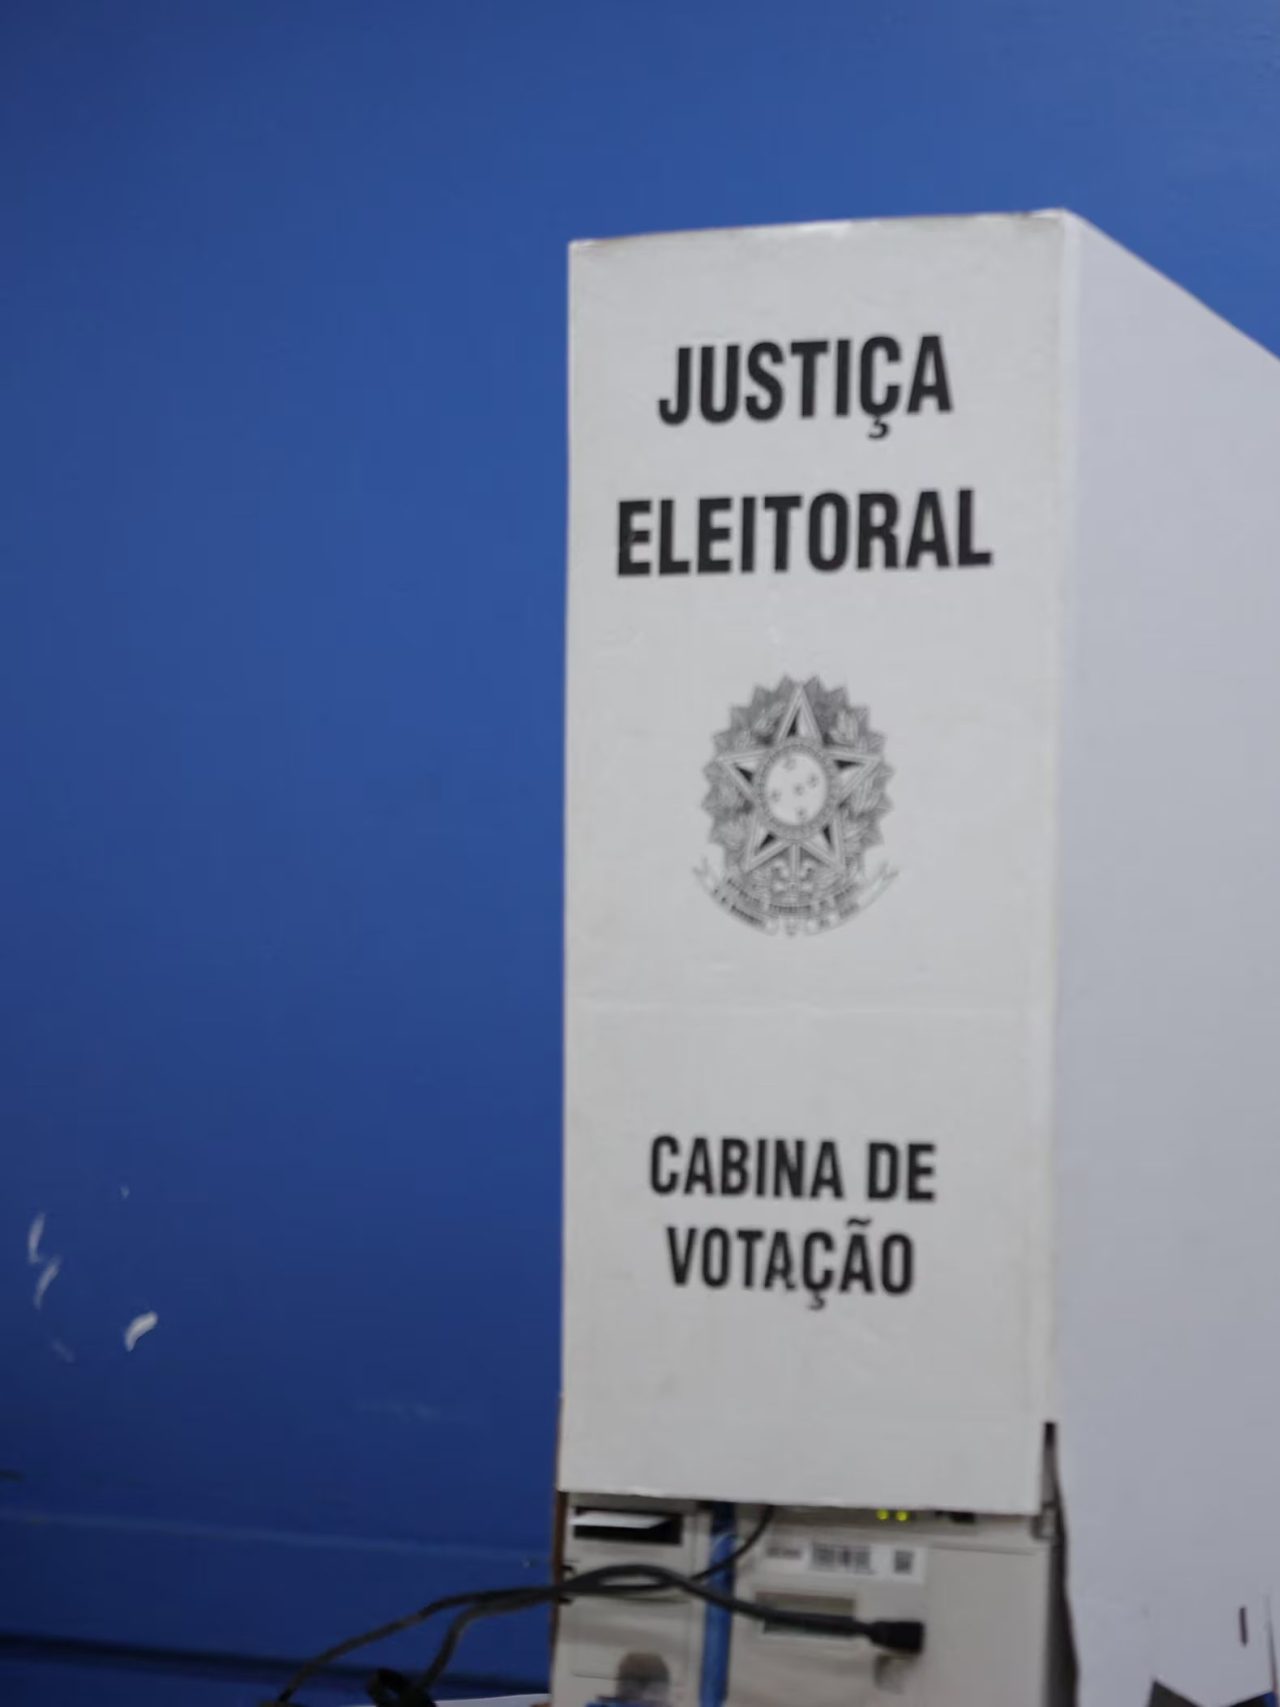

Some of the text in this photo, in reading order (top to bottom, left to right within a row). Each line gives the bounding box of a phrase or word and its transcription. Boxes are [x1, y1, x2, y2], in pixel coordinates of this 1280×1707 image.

[657, 334, 953, 440] JUSTIÇA
[616, 488, 993, 578] ELEITORAL
[649, 1133, 937, 1203] CABINA DE
[665, 1216, 915, 1311] VOTAÇÃO
